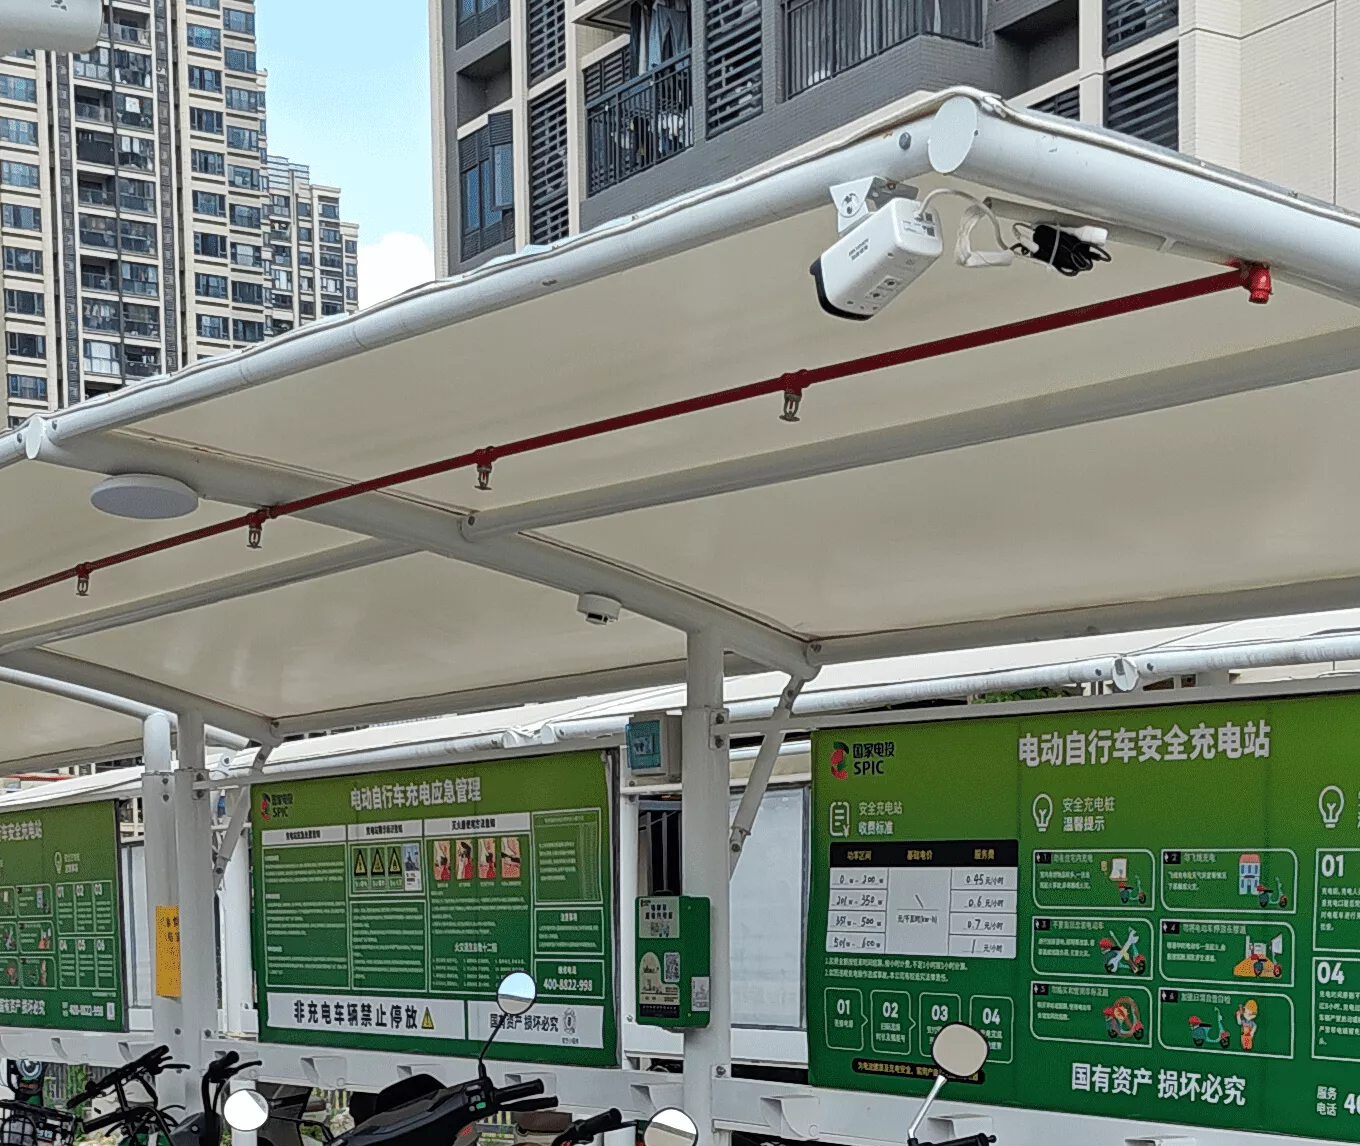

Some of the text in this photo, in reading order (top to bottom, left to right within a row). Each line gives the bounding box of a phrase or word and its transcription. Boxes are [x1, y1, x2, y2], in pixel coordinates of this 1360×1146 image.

[853, 741, 895, 758] 国家电投
[1018, 720, 1271, 767] 电动自行车安全充电站
[854, 760, 884, 776] SPIC
[351, 777, 482, 812] 电动自行车充电应急管理
[859, 801, 903, 816] 安全充电站
[1062, 796, 1115, 813] 安全充电桩
[858, 820, 893, 836] 收费标准
[1062, 815, 1105, 832] 温馨提示
[1321, 854, 1344, 877] 01
[1316, 961, 1345, 985] 04
[293, 1000, 418, 1029] 非充电车辆禁止停放
[836, 999, 850, 1015] 01
[882, 1002, 899, 1018] 02
[931, 1005, 949, 1021] 03
[524, 1015, 559, 1032] 损坏必究
[982, 1008, 1001, 1025] 04
[1071, 1062, 1247, 1106] 国有资产 损坏必究
[1316, 1085, 1338, 1101] 服务
[1316, 1102, 1338, 1117] 电话
